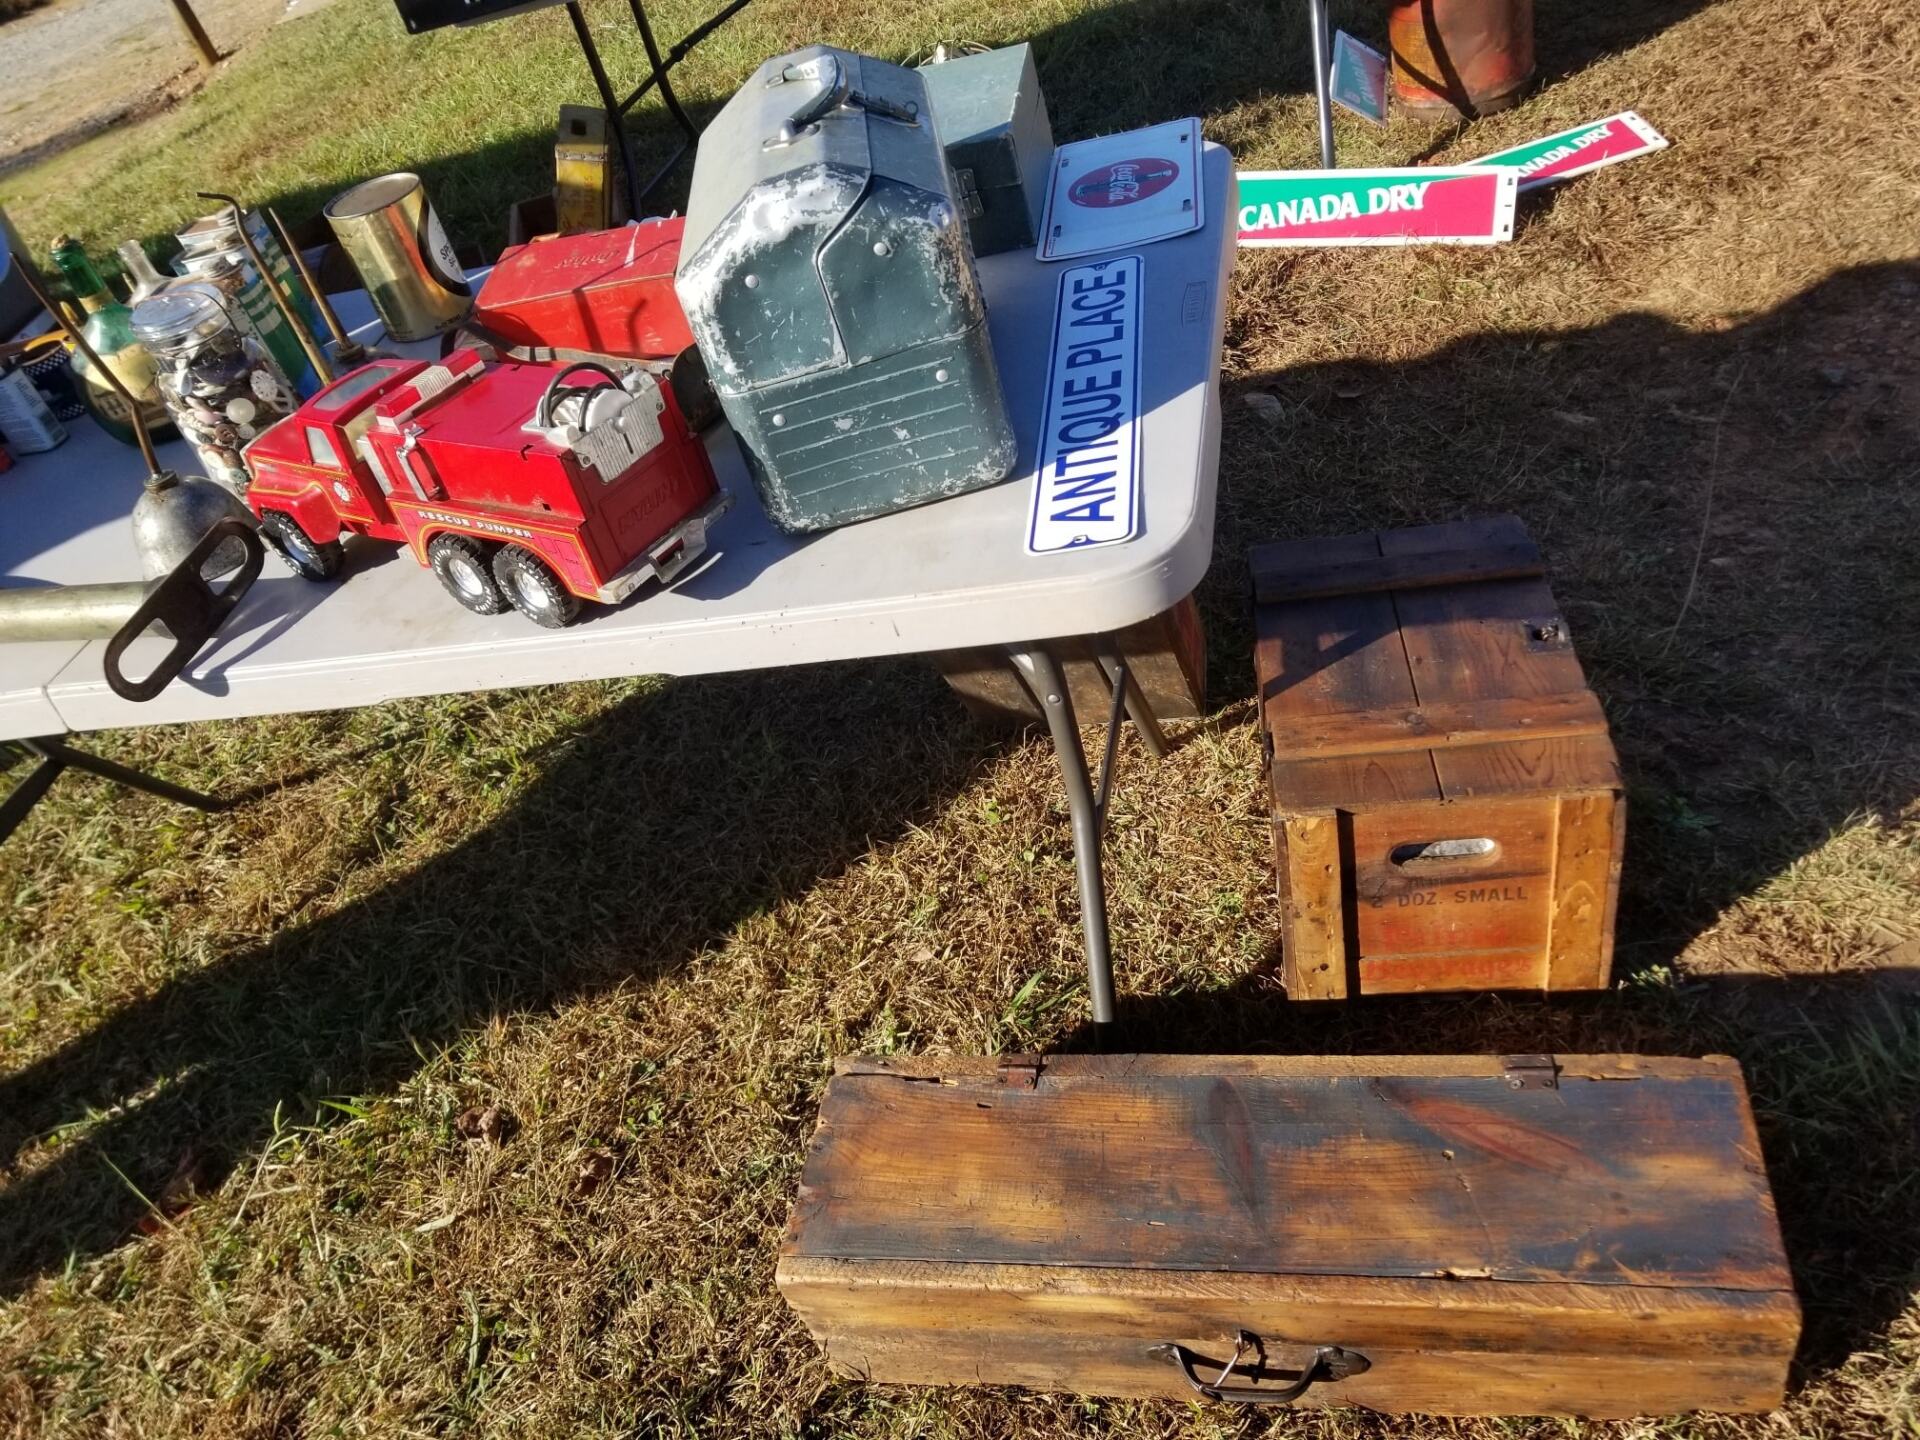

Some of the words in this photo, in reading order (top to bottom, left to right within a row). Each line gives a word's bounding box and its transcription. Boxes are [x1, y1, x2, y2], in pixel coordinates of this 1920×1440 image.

[1518, 145, 1575, 178] NADA
[1570, 124, 1613, 150] DRY
[1238, 191, 1361, 232] CANADA
[1367, 181, 1431, 215] DRY
[1065, 269, 1126, 371] PLACE
[1050, 369, 1125, 522] ANTIQUE
[417, 510, 472, 528] RESCUE
[476, 521, 534, 540] PUMPER
[1454, 886, 1529, 904] SMALL
